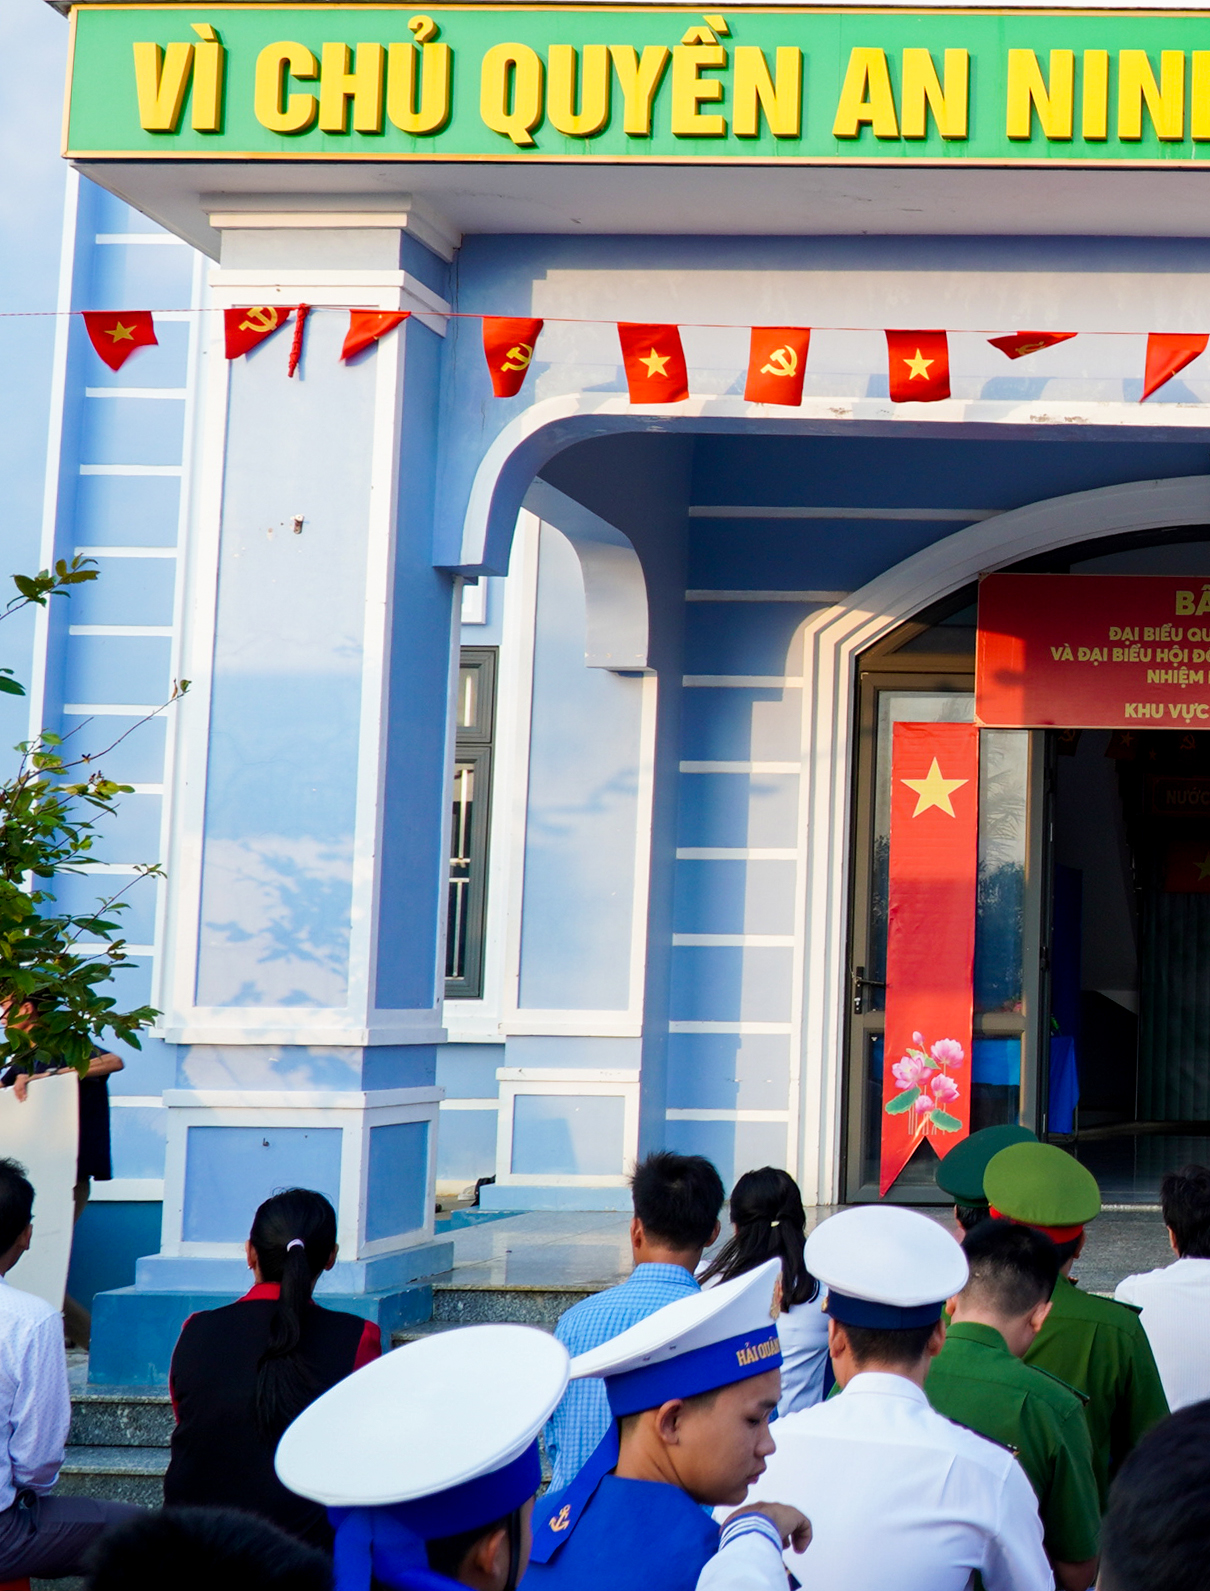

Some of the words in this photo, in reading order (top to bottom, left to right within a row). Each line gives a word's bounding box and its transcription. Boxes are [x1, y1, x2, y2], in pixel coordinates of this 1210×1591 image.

[133, 23, 225, 134] VÌ
[254, 15, 453, 136] CHỦ
[480, 15, 803, 147] QUYỀN
[832, 47, 970, 141] AN
[1108, 626, 1140, 645] ĐẠI
[1143, 623, 1183, 642] BIỂU
[1050, 643, 1074, 661] VÀ
[1077, 647, 1108, 666] ĐẠI
[1112, 643, 1152, 662] BIỂU
[1156, 645, 1189, 667] HỘI
[1147, 666, 1204, 688] NHIỆM
[1124, 703, 1164, 719] KHU
[1168, 702, 1210, 724] VỰC
[1166, 787, 1210, 806] NƯỚC
[735, 1341, 760, 1367] HẢI
